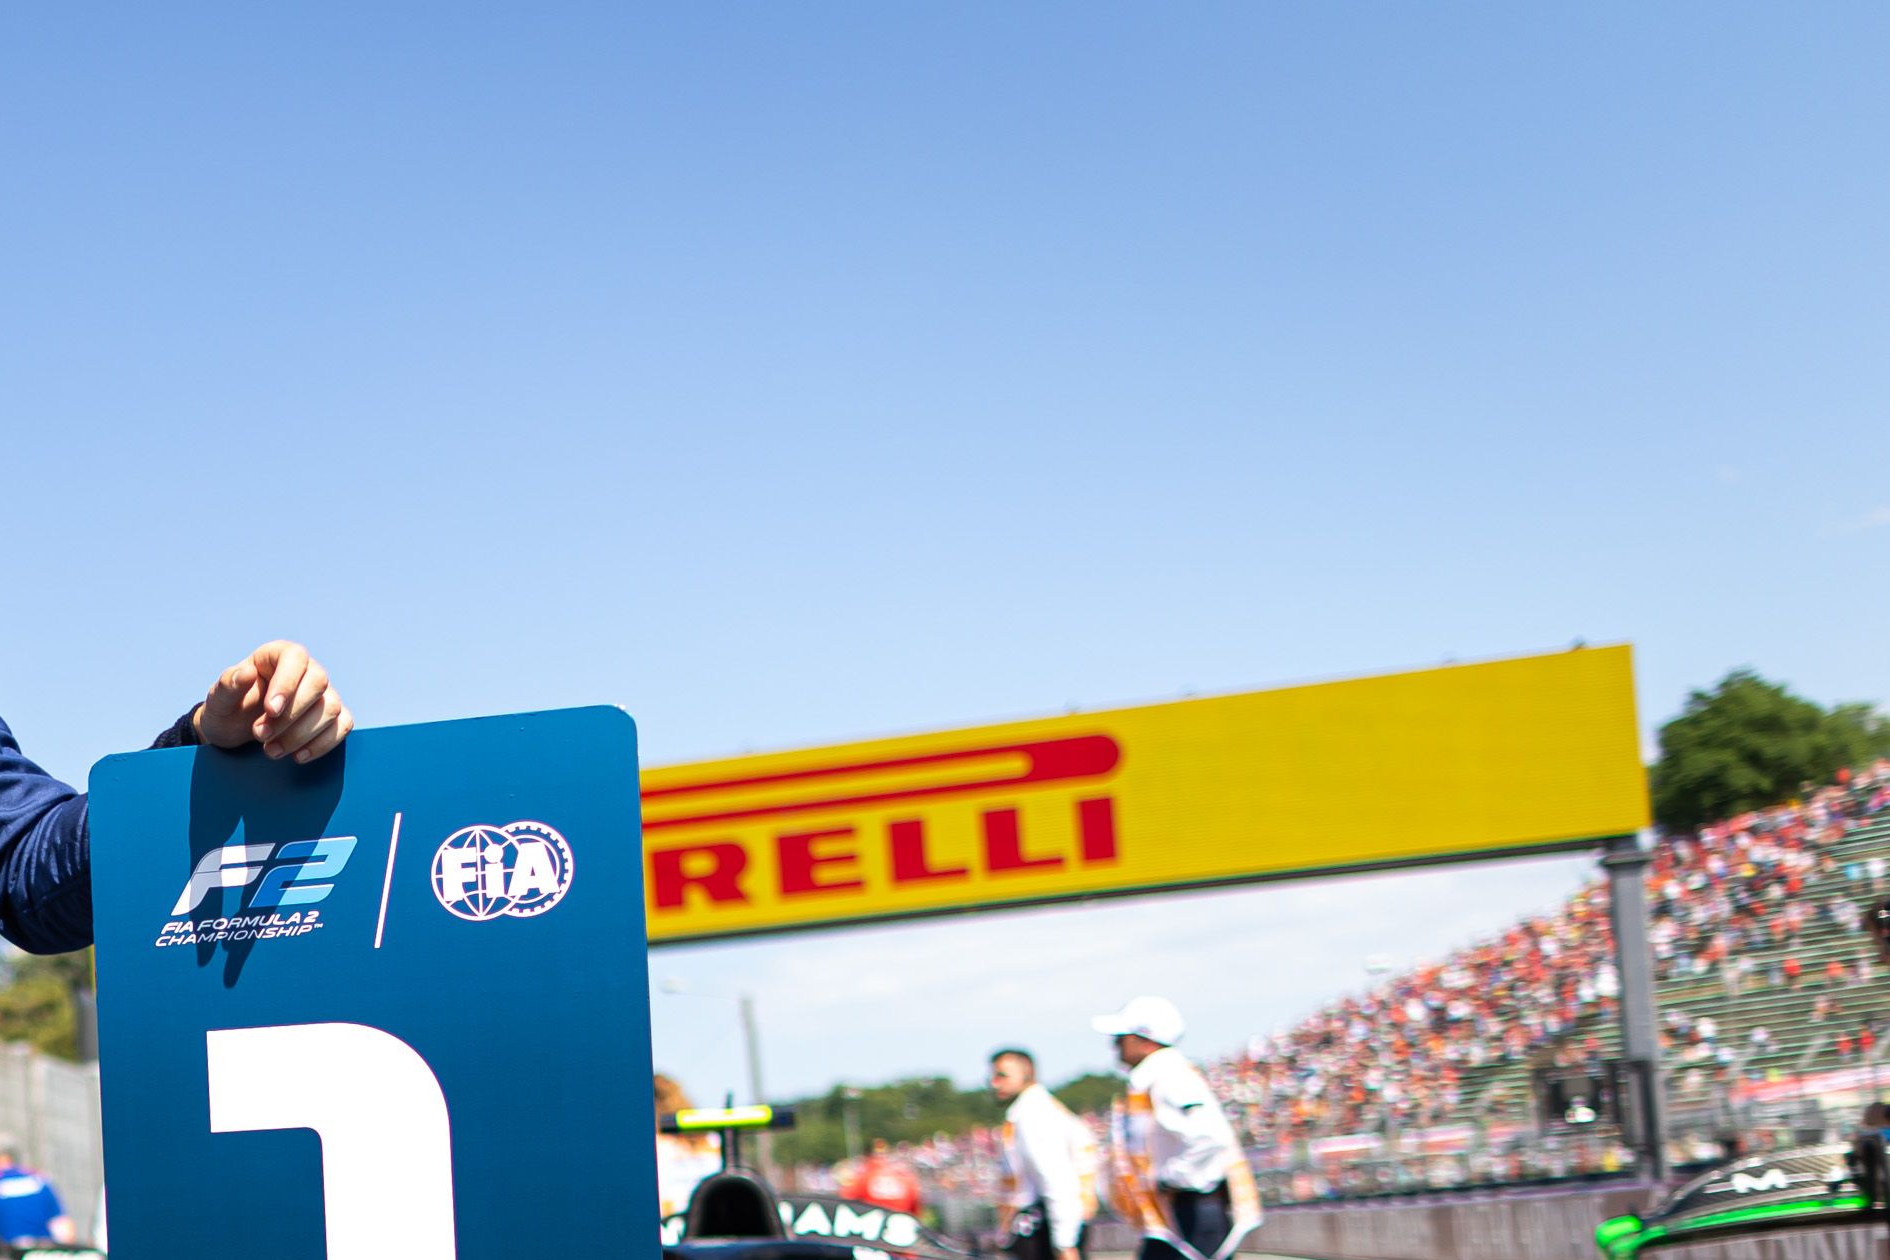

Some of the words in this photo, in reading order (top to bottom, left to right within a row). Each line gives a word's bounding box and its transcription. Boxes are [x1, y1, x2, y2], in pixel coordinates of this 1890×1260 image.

[170, 835, 358, 917] F2
[160, 920, 195, 935] FIA
[197, 912, 301, 931] FORMULA
[303, 910, 320, 924] 2
